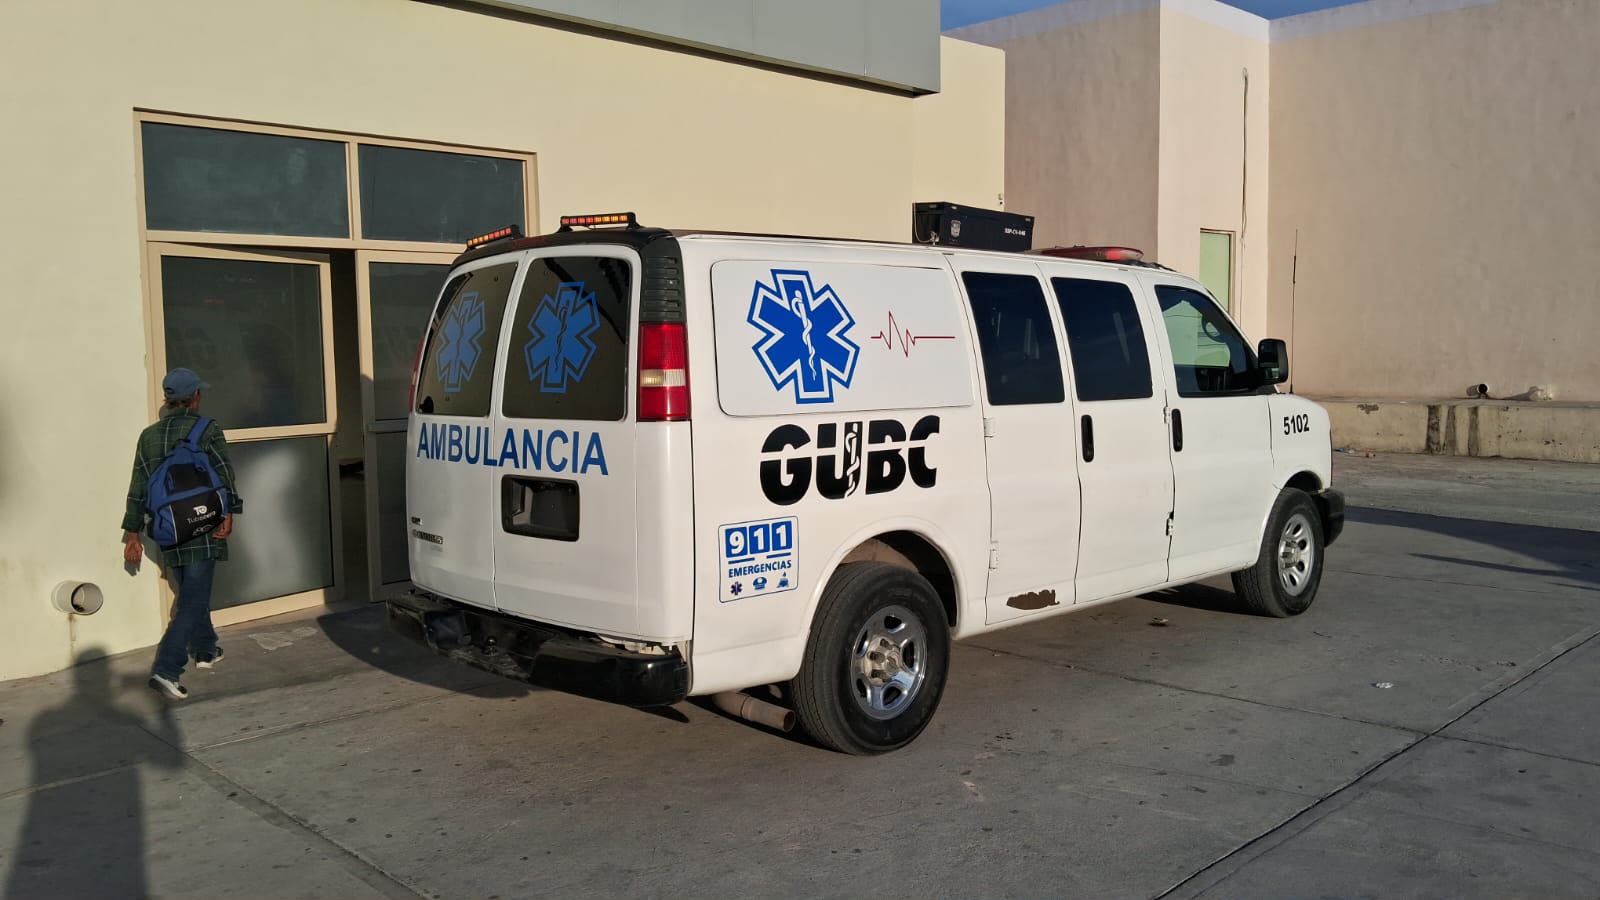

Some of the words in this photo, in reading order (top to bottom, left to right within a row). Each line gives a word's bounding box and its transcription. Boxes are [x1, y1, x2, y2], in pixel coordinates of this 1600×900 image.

[1283, 413, 1310, 435] 5102
[416, 422, 609, 475] AMBULANCIA
[728, 523, 788, 555] 911
[728, 559, 792, 578] EMERGENCIAS
